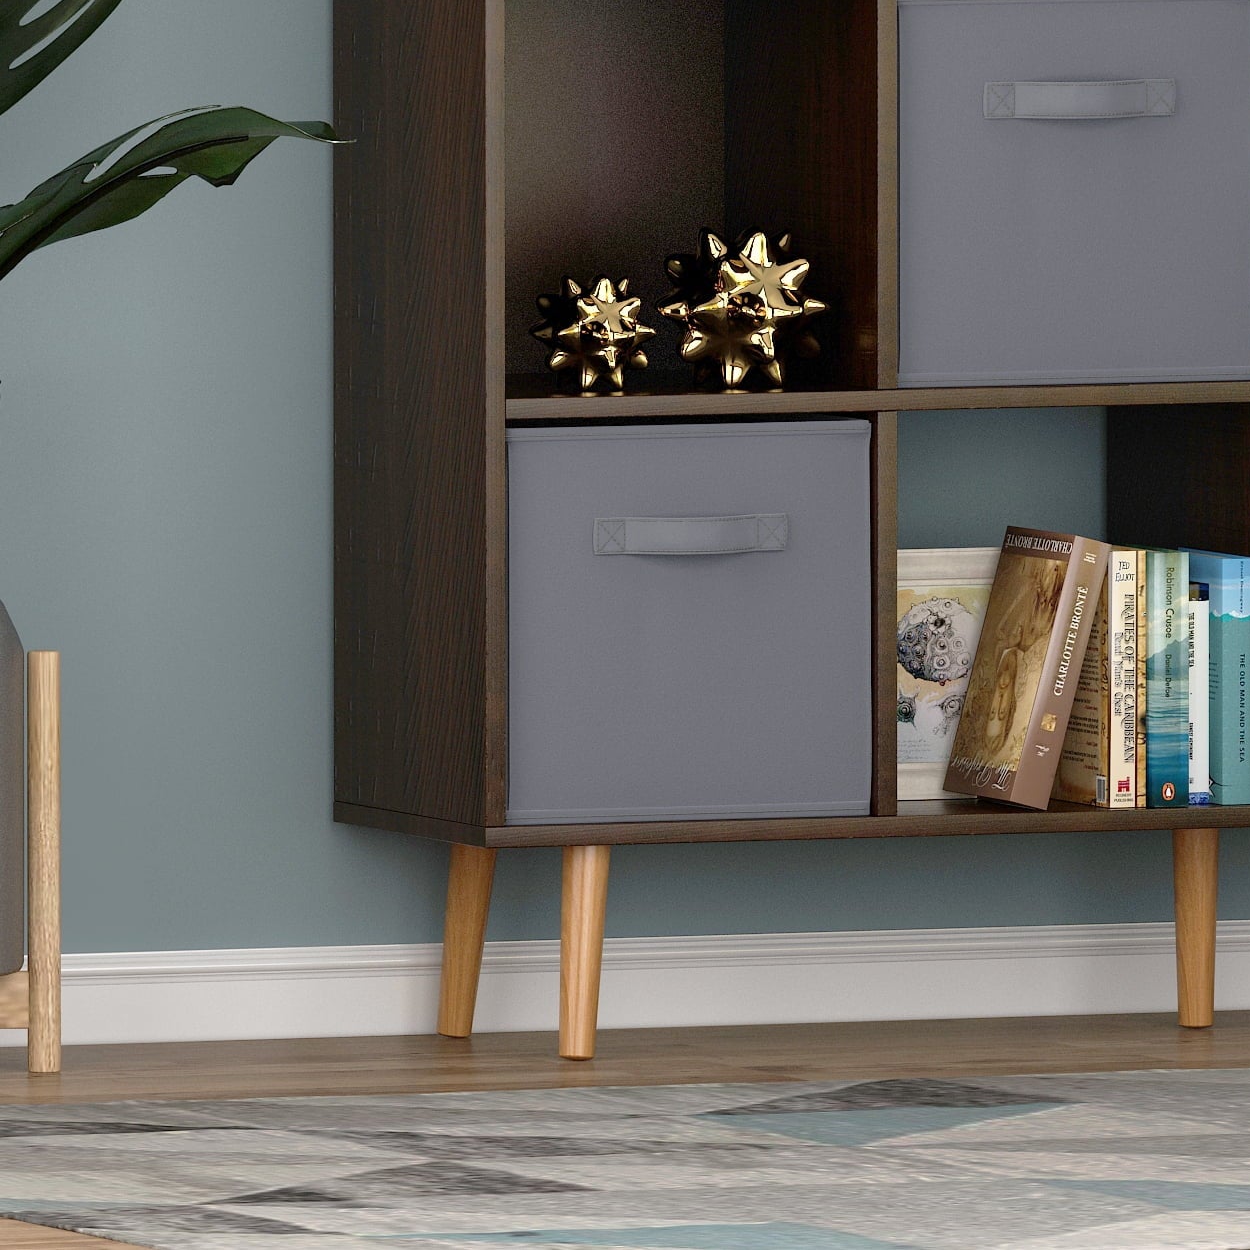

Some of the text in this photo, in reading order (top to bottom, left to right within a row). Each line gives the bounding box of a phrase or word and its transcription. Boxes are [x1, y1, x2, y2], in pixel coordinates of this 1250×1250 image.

[1032, 538, 1073, 554] CHARLOTTE
[1165, 567, 1175, 639] Robinson Crusoe
[1053, 631, 1078, 696] CHARLOTTE
[1121, 594, 1135, 764] PIRATES OF THE CARIBBEAN
[1165, 654, 1173, 698] Daniel Defoe
